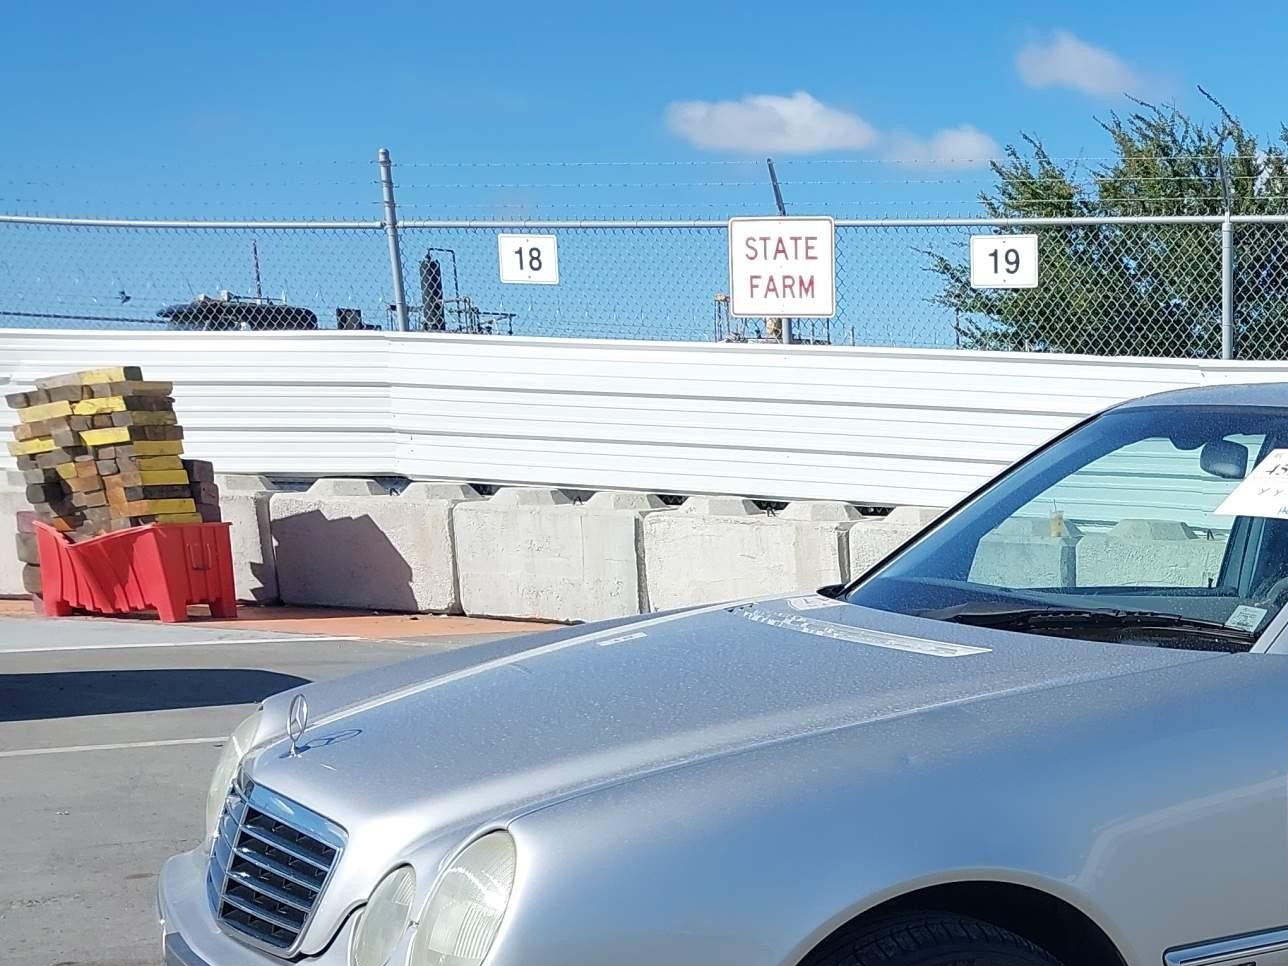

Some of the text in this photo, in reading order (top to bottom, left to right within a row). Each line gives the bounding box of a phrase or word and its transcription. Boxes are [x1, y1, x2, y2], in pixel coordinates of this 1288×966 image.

[514, 246, 543, 272] 18
[745, 236, 819, 261] STATE
[988, 248, 1020, 275] 19
[749, 274, 815, 299] FARM
